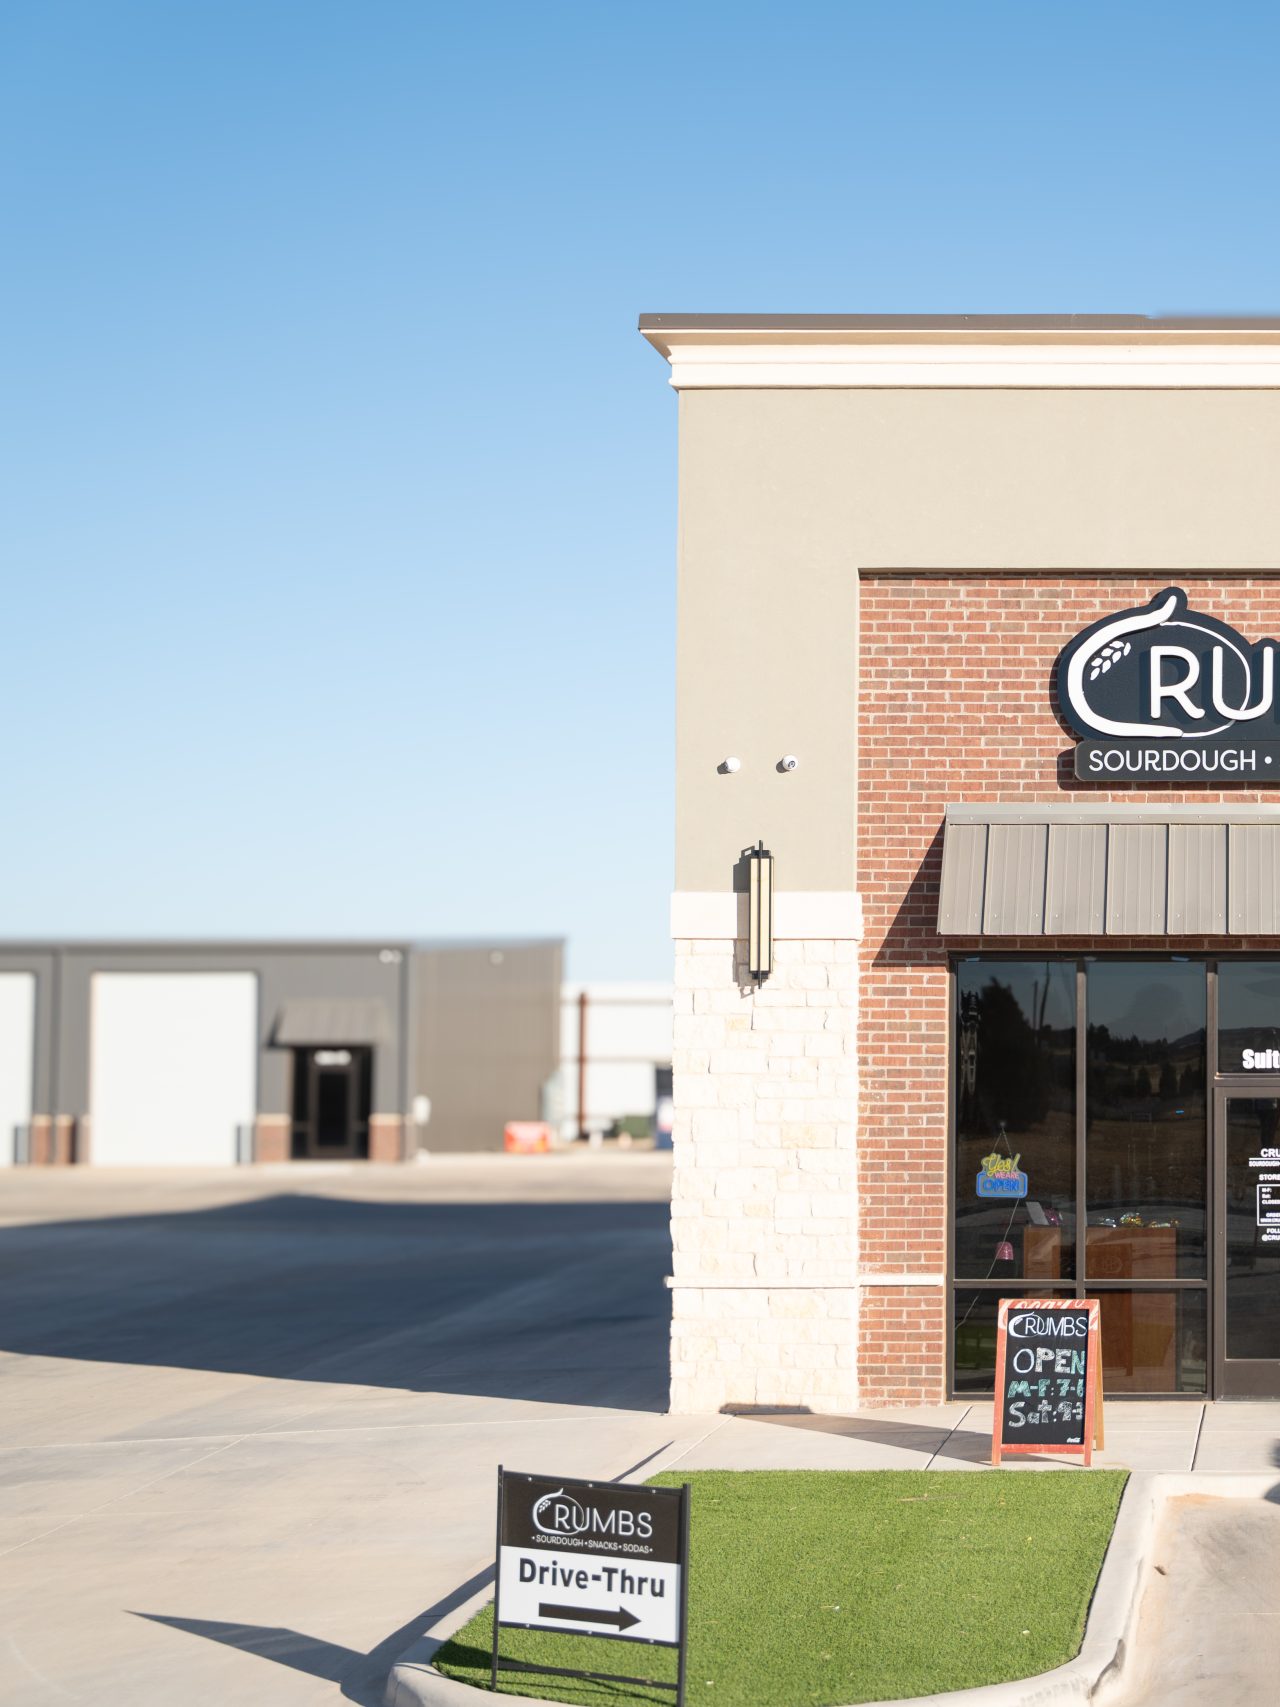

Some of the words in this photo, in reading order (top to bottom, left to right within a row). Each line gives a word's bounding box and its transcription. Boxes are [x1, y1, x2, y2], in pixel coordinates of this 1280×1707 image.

[1088, 749, 1257, 772] SOURDOUGH
[981, 1152, 1021, 1177] Yes!
[983, 1178, 1020, 1192] OPEN
[1008, 1311, 1088, 1338] CRUMBS
[1013, 1346, 1085, 1375] OPEN
[532, 1487, 654, 1538] CRUMBS
[536, 1534, 584, 1547] SOURDOUGH
[588, 1539, 618, 1551] SNACKS
[622, 1543, 650, 1554] SODAS
[519, 1557, 665, 1598] Drive-Thru
